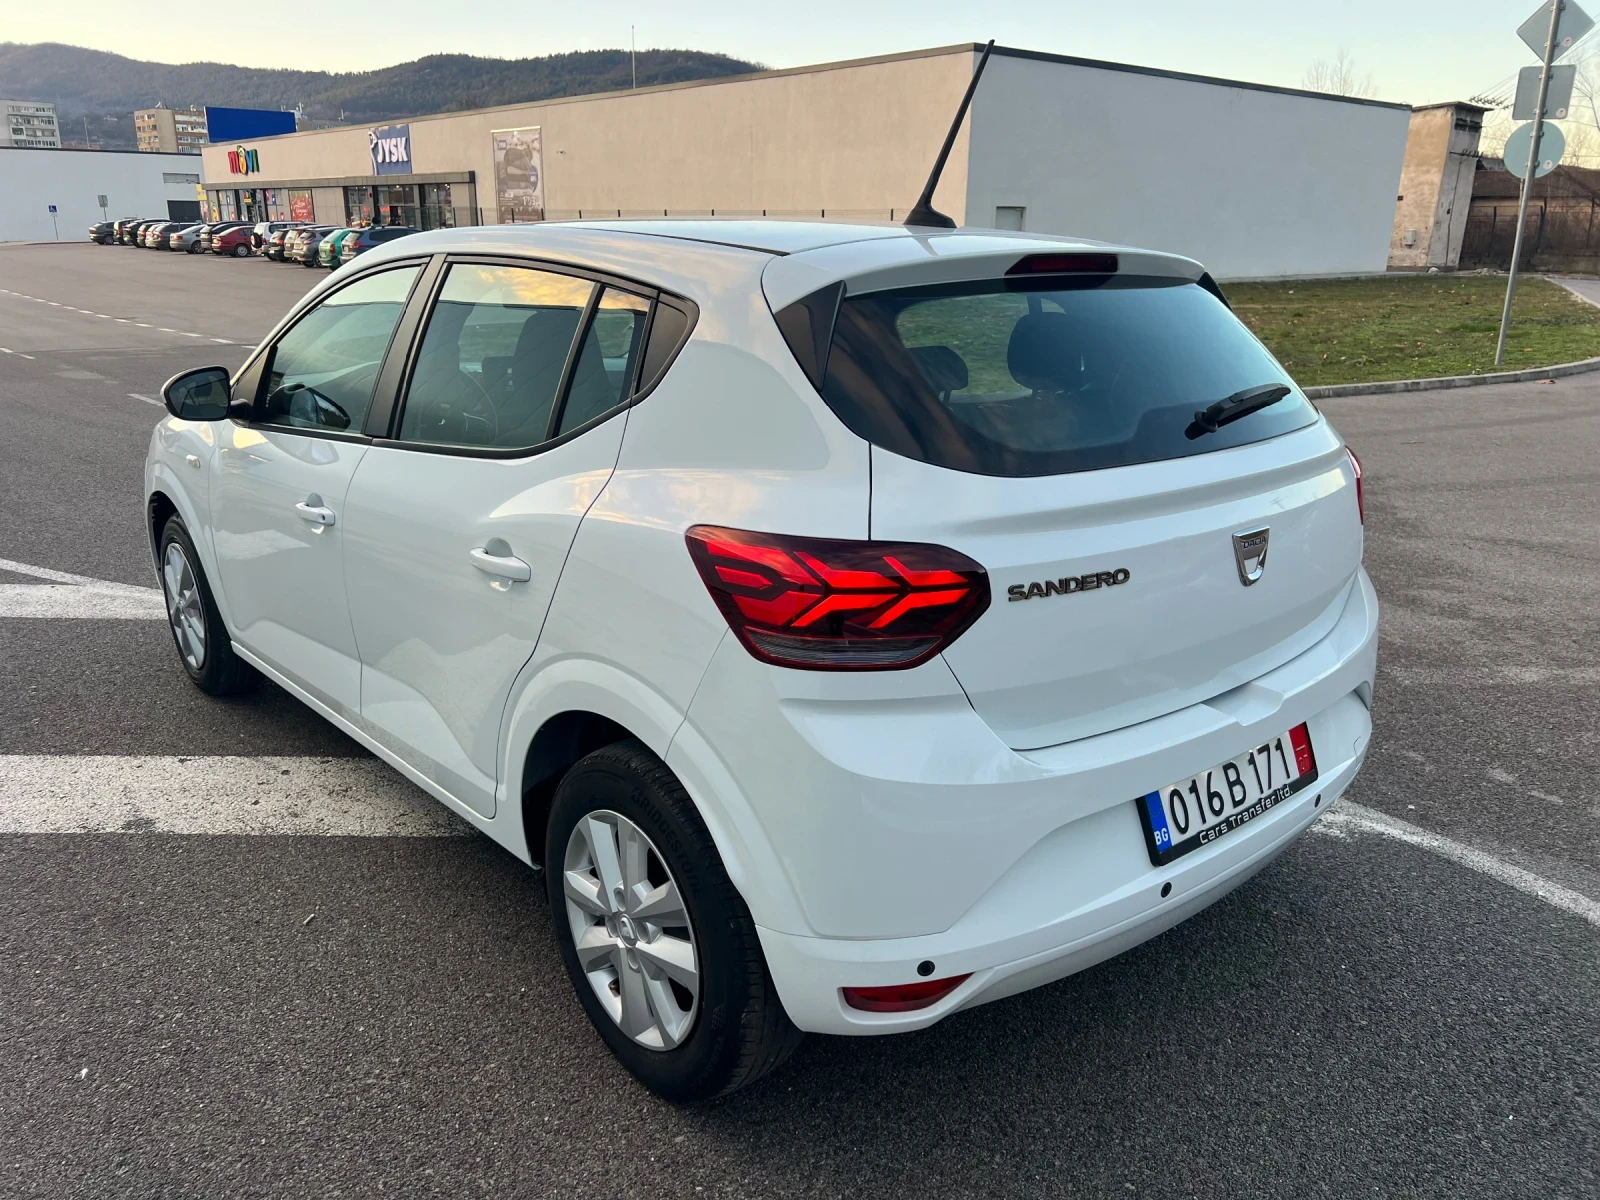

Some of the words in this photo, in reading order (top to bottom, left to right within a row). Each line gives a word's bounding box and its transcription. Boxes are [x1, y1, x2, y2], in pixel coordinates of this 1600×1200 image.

[377, 137, 408, 163] JYSK
[1243, 536, 1267, 549] DACIA
[1008, 568, 1130, 602] SANDERO
[1199, 820, 1228, 845] Cars
[1229, 796, 1276, 827] Transfer
[1276, 785, 1294, 803] ltd.
[1153, 827, 1170, 846] BG
